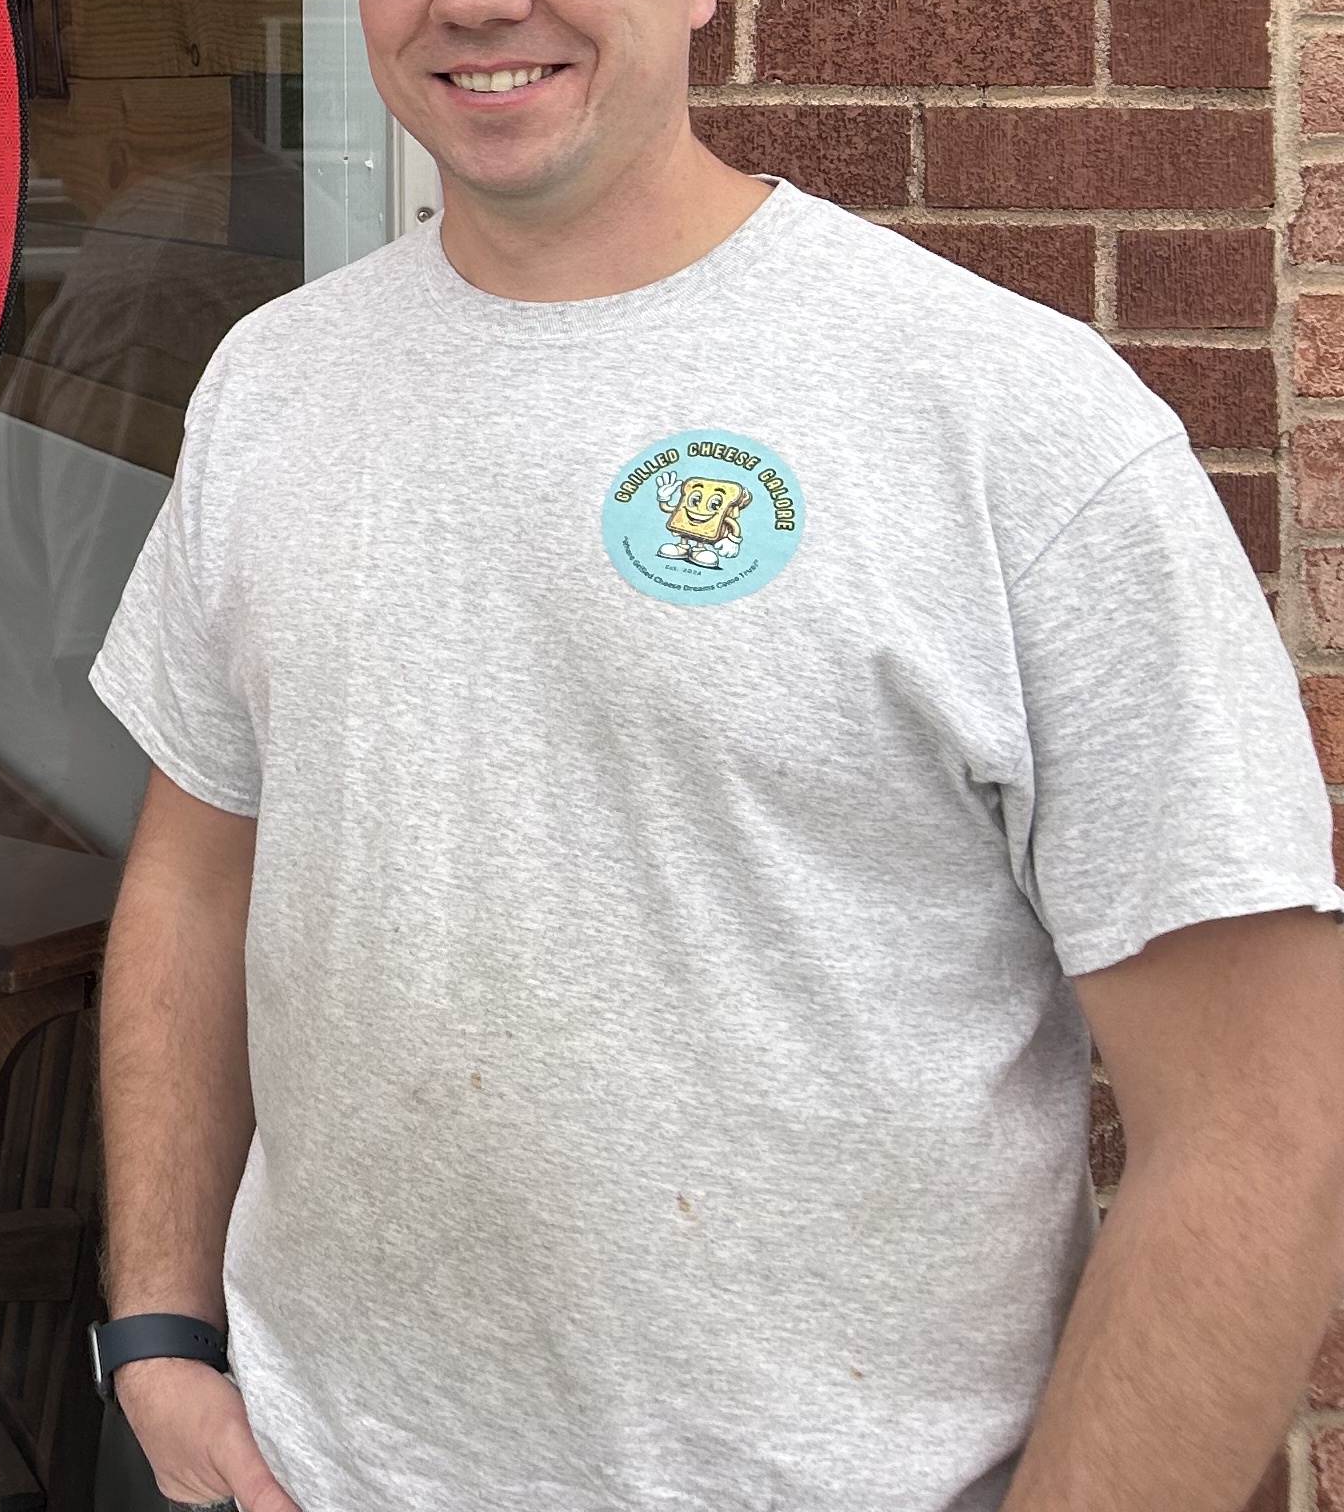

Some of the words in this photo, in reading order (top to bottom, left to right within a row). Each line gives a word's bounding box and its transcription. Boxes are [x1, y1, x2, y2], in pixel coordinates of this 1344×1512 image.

[614, 448, 680, 503] GRILLED
[687, 441, 761, 471] CHEESE
[758, 468, 796, 531] GALORE
